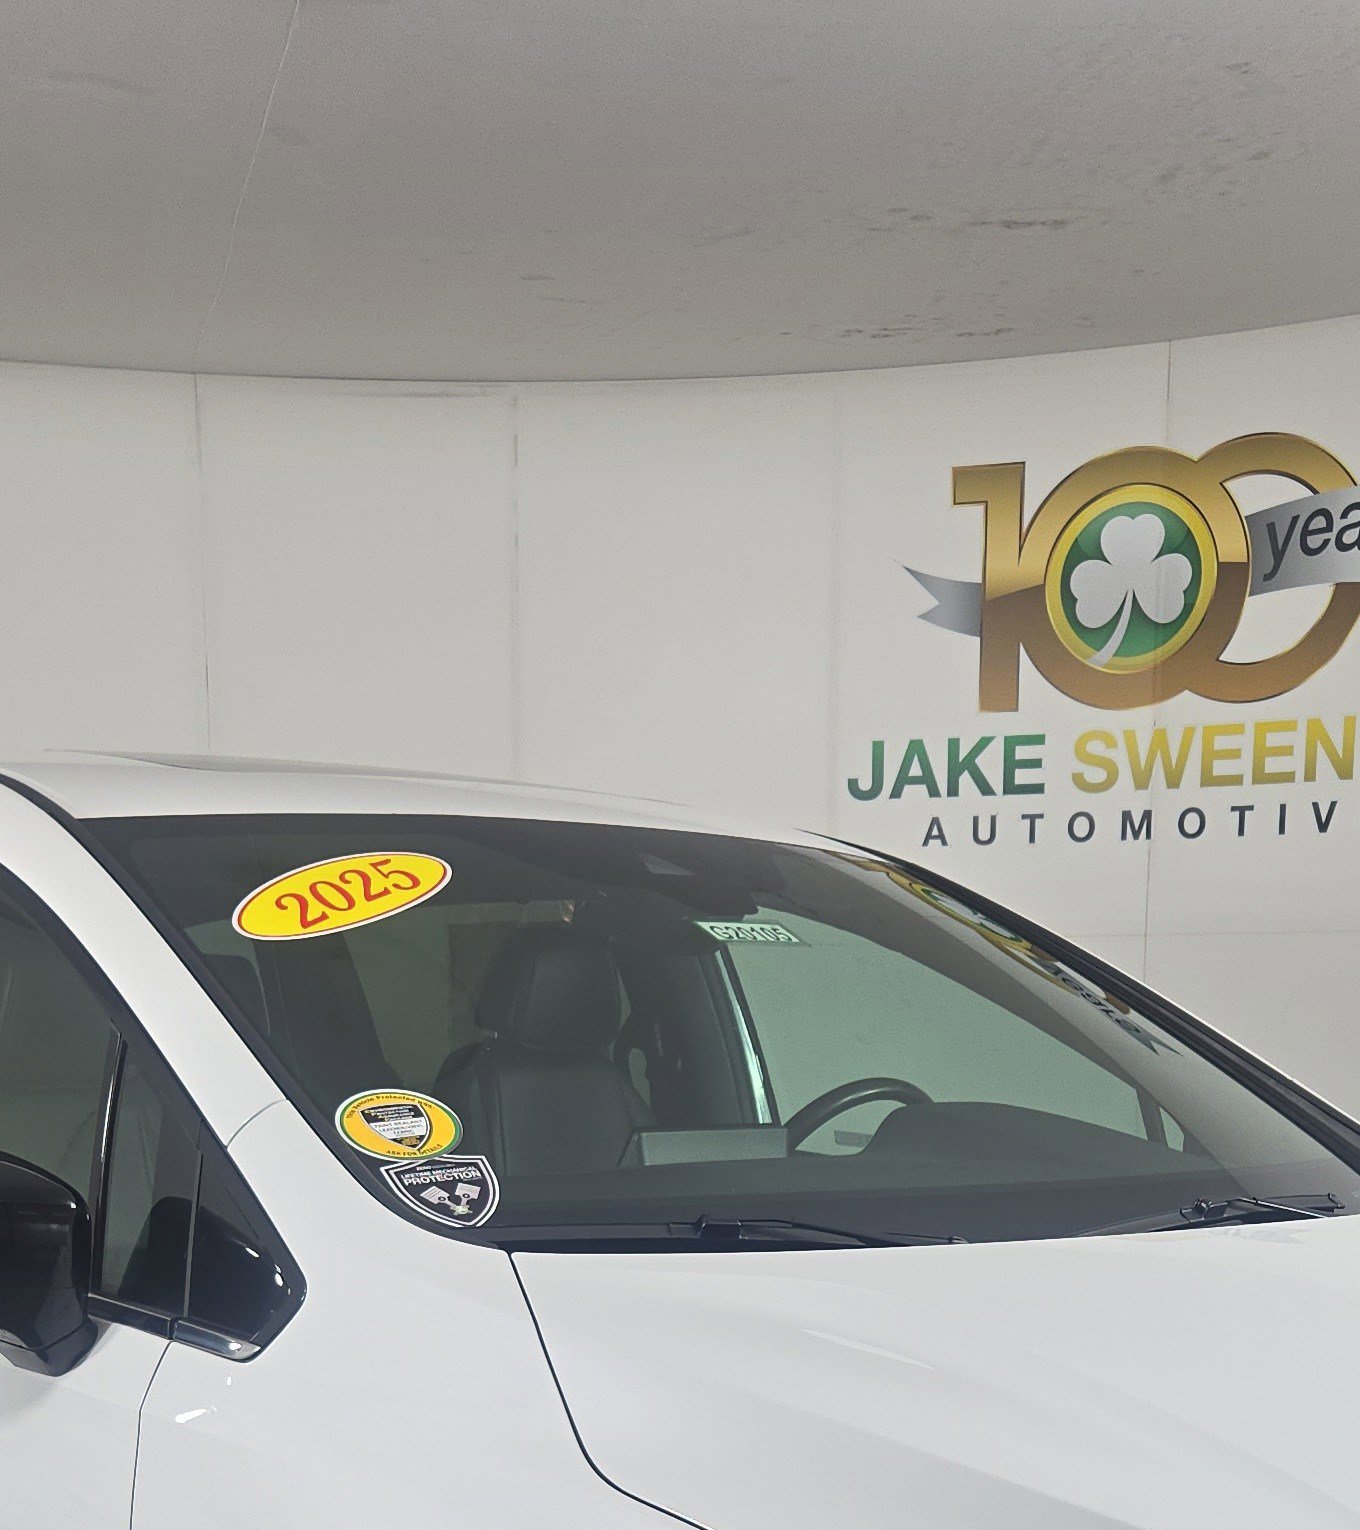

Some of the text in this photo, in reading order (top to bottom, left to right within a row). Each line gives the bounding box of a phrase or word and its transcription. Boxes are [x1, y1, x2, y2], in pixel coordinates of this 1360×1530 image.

[847, 734, 1047, 802] JAKE
[274, 858, 421, 929] 2025
[403, 1169, 483, 1186] PROTECTION
